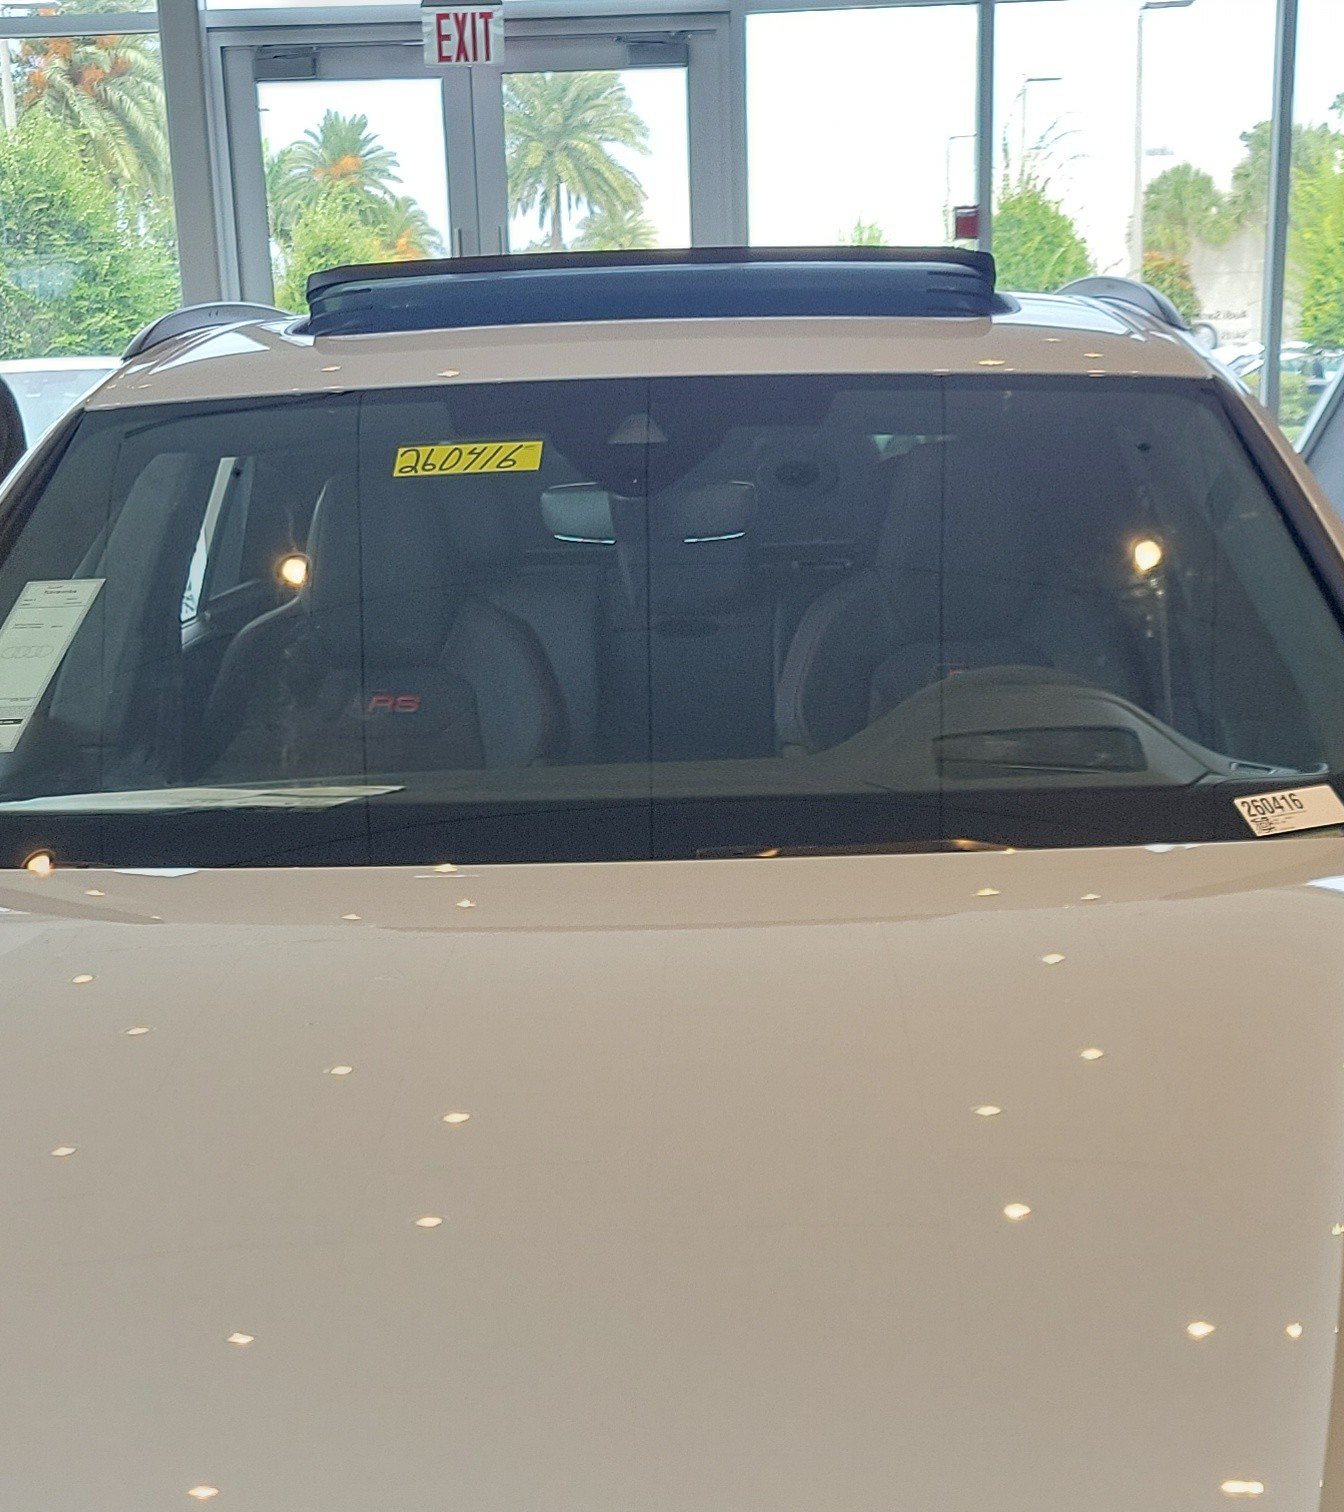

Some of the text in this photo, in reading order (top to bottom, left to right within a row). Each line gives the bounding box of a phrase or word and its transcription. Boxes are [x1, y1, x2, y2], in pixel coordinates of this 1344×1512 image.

[435, 11, 494, 63] EXIT
[398, 444, 524, 474] 260416
[1240, 792, 1304, 818] 260416
